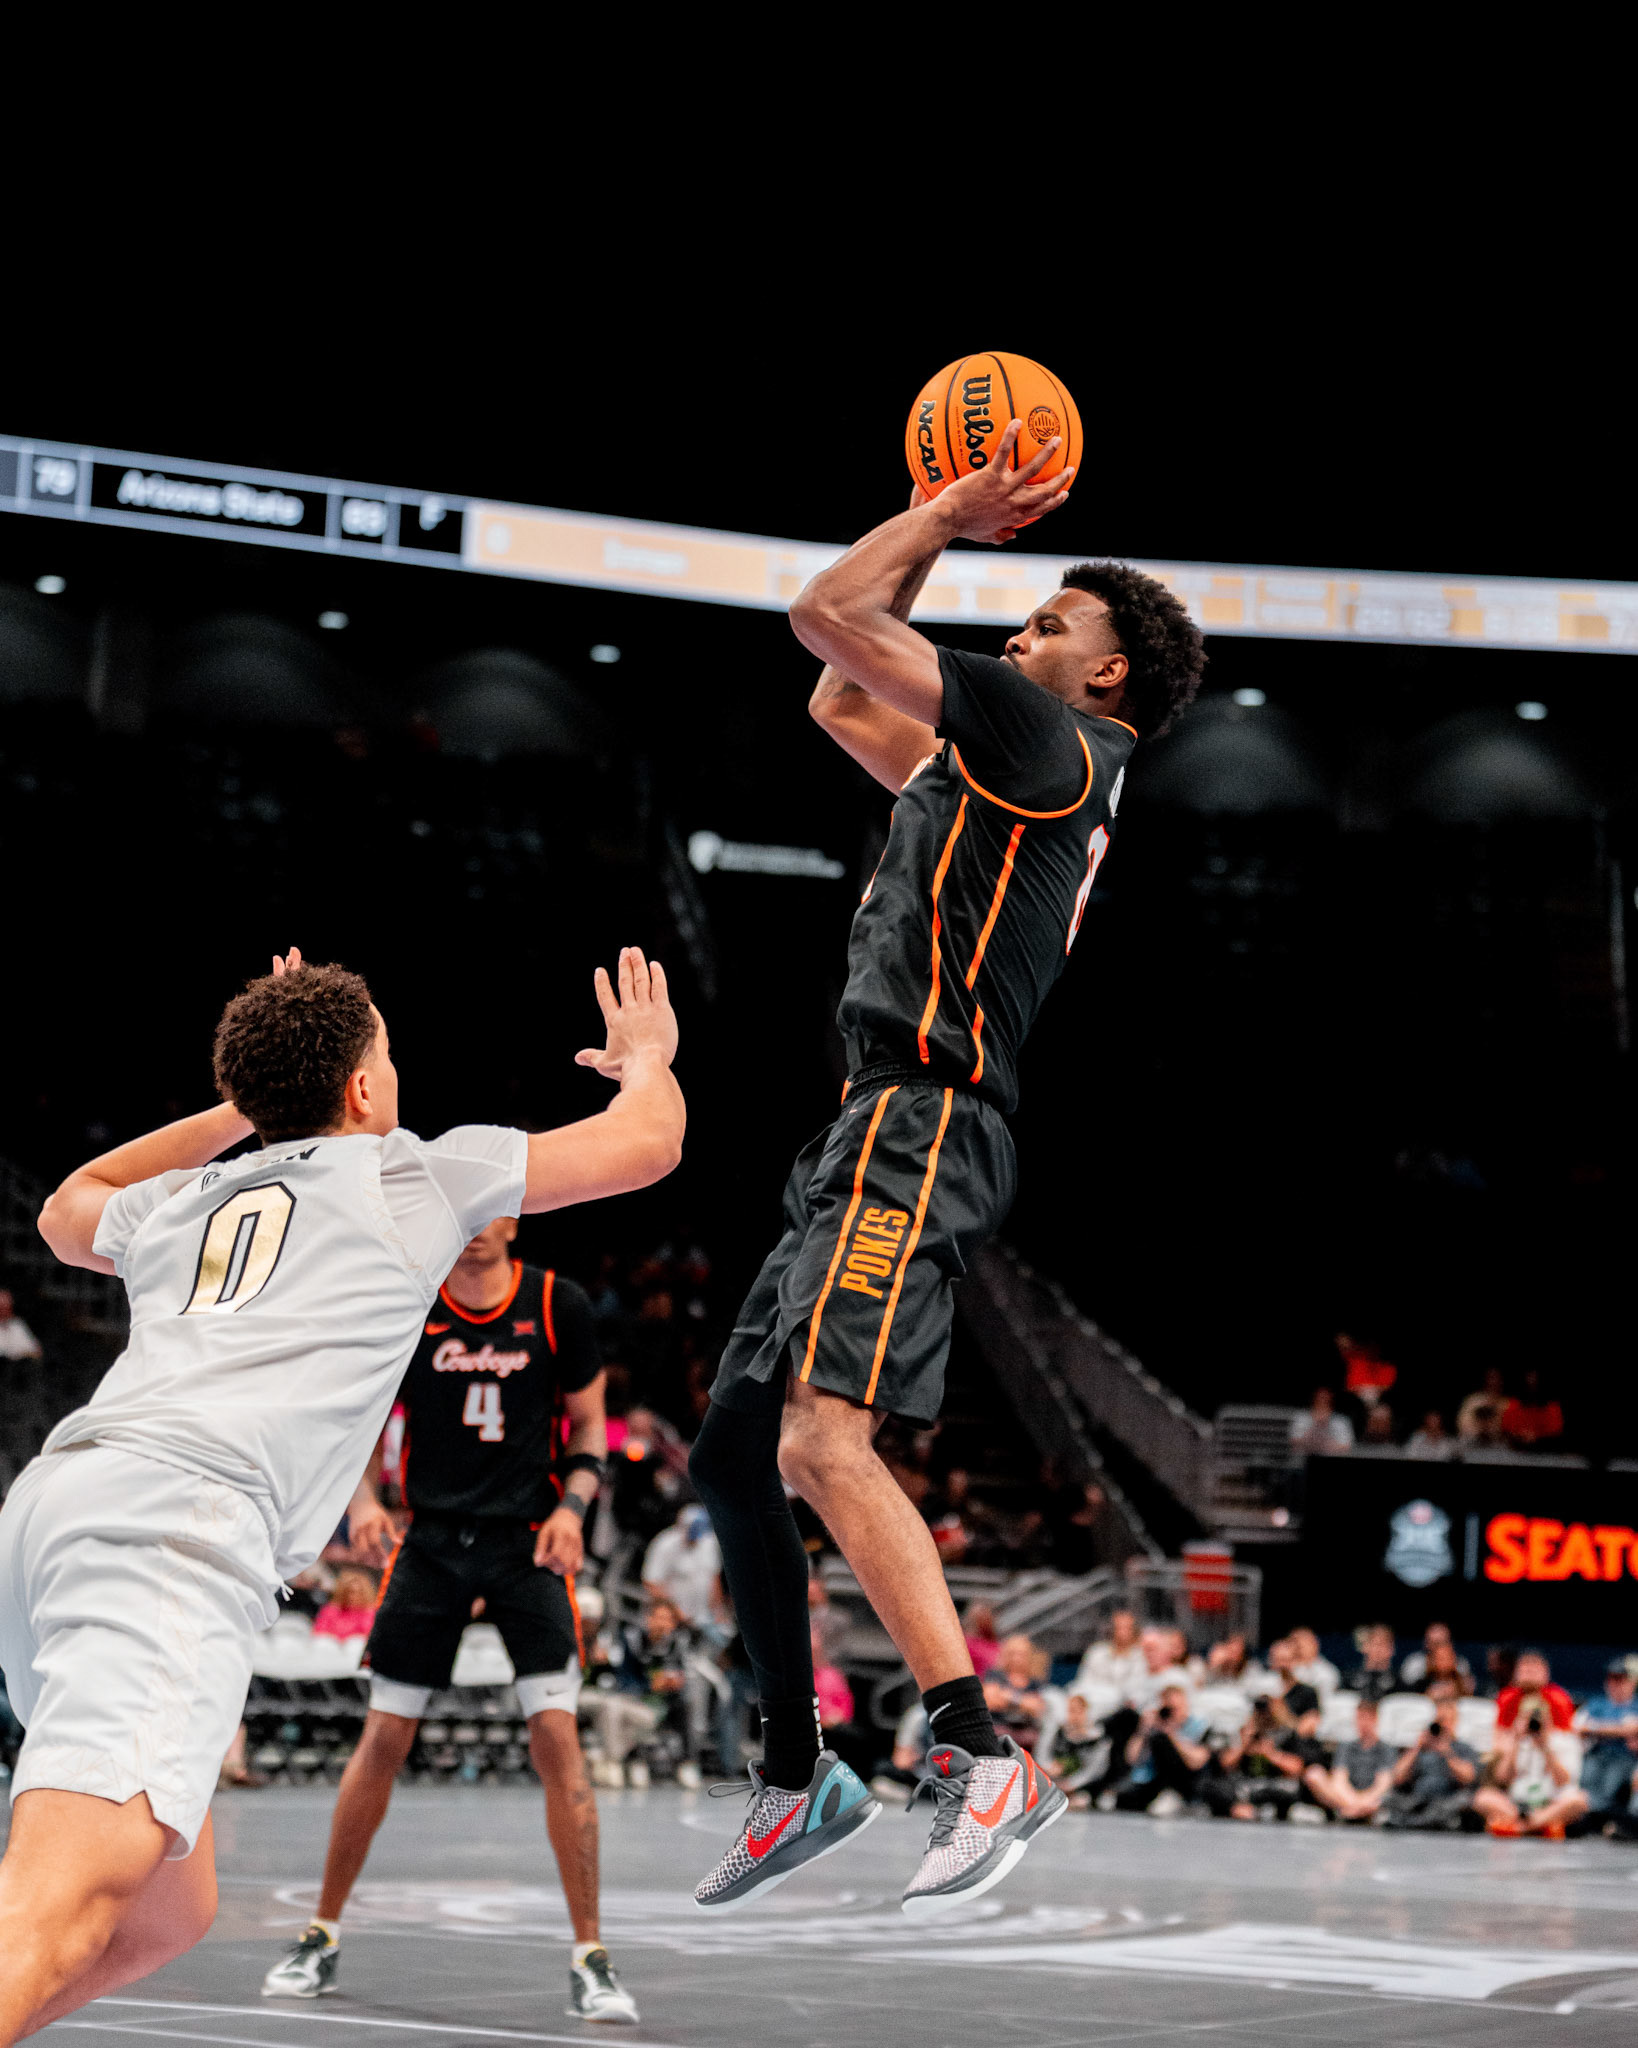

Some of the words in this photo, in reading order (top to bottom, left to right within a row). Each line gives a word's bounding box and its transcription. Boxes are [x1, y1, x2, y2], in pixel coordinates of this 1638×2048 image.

[917, 400, 944, 484] NCAA
[962, 374, 994, 470] Wilso
[117, 469, 221, 516] Arizona
[222, 481, 304, 527] State
[177, 1181, 297, 1316] 0
[838, 1206, 910, 1300] POKES
[432, 1338, 531, 1379] Cowboys
[462, 1381, 506, 1443] 4
